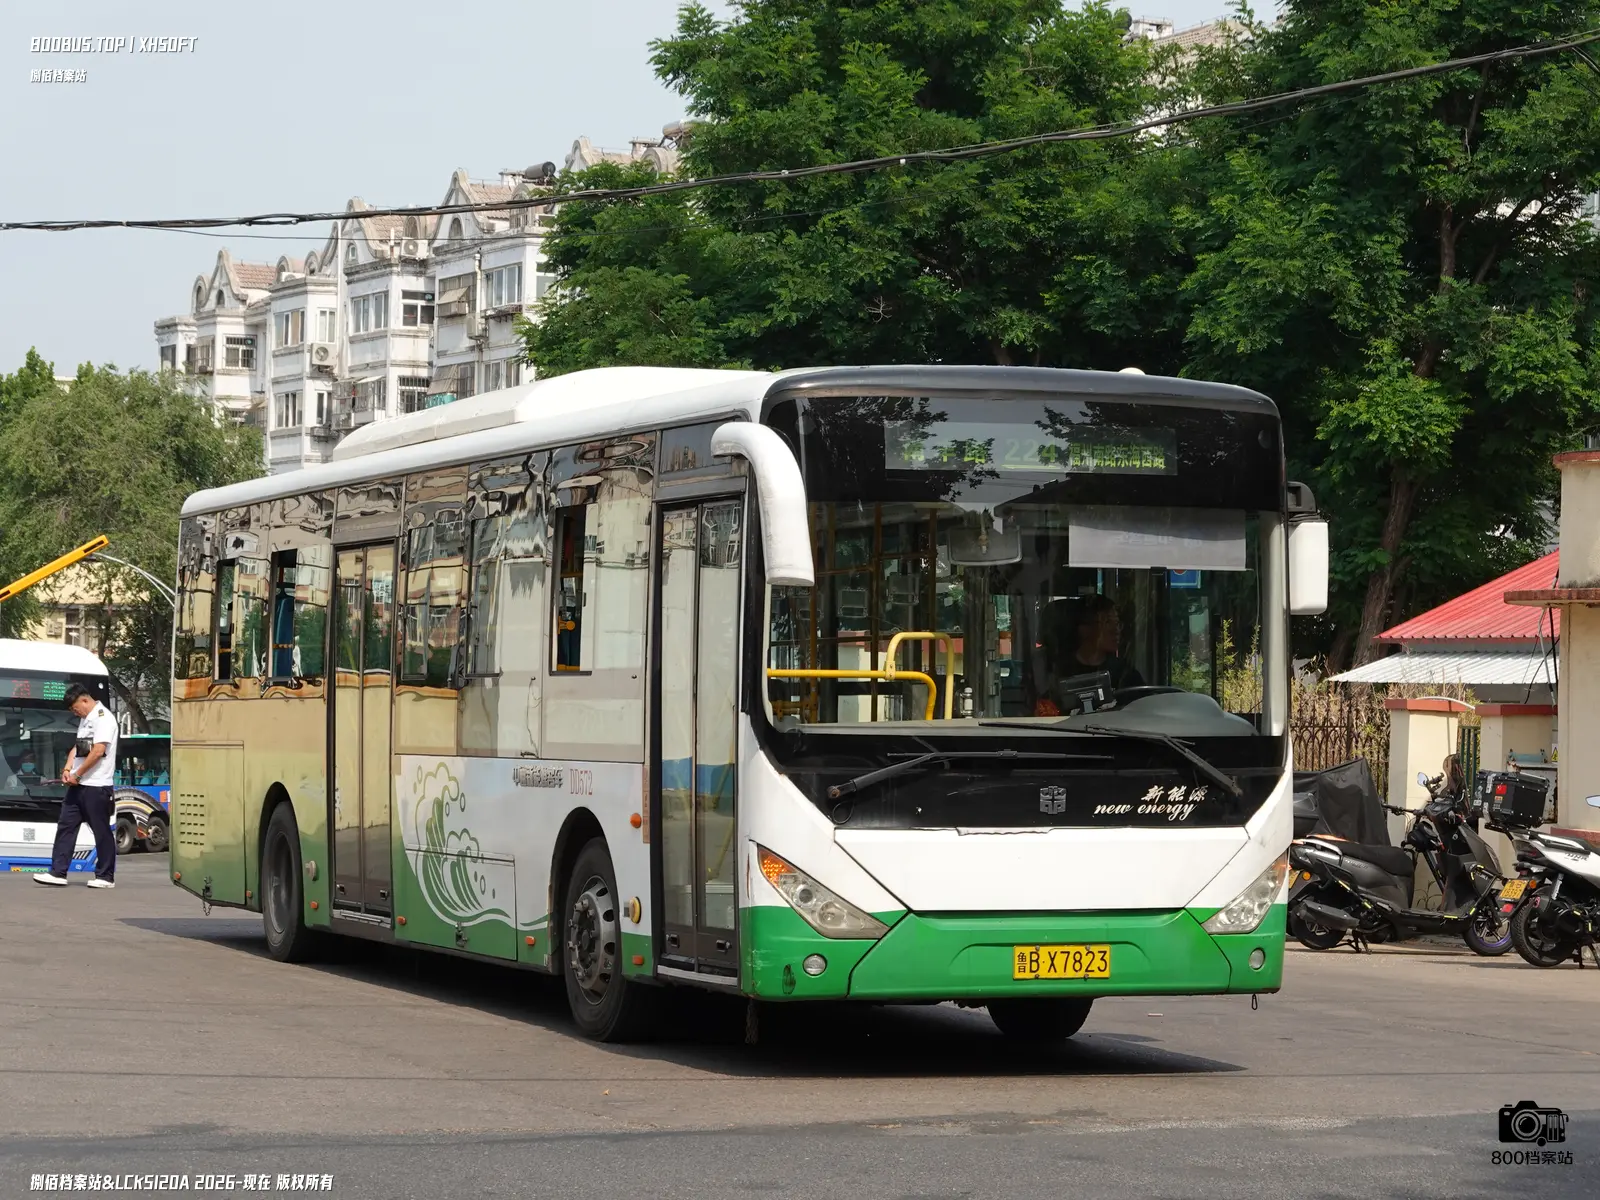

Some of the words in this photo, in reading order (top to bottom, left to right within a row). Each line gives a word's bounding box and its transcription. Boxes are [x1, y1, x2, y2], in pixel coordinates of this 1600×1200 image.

[1005, 438, 1059, 463] 224
[1141, 785, 1209, 803] 新能源
[1094, 803, 1134, 815] new
[1137, 803, 1198, 821] energy
